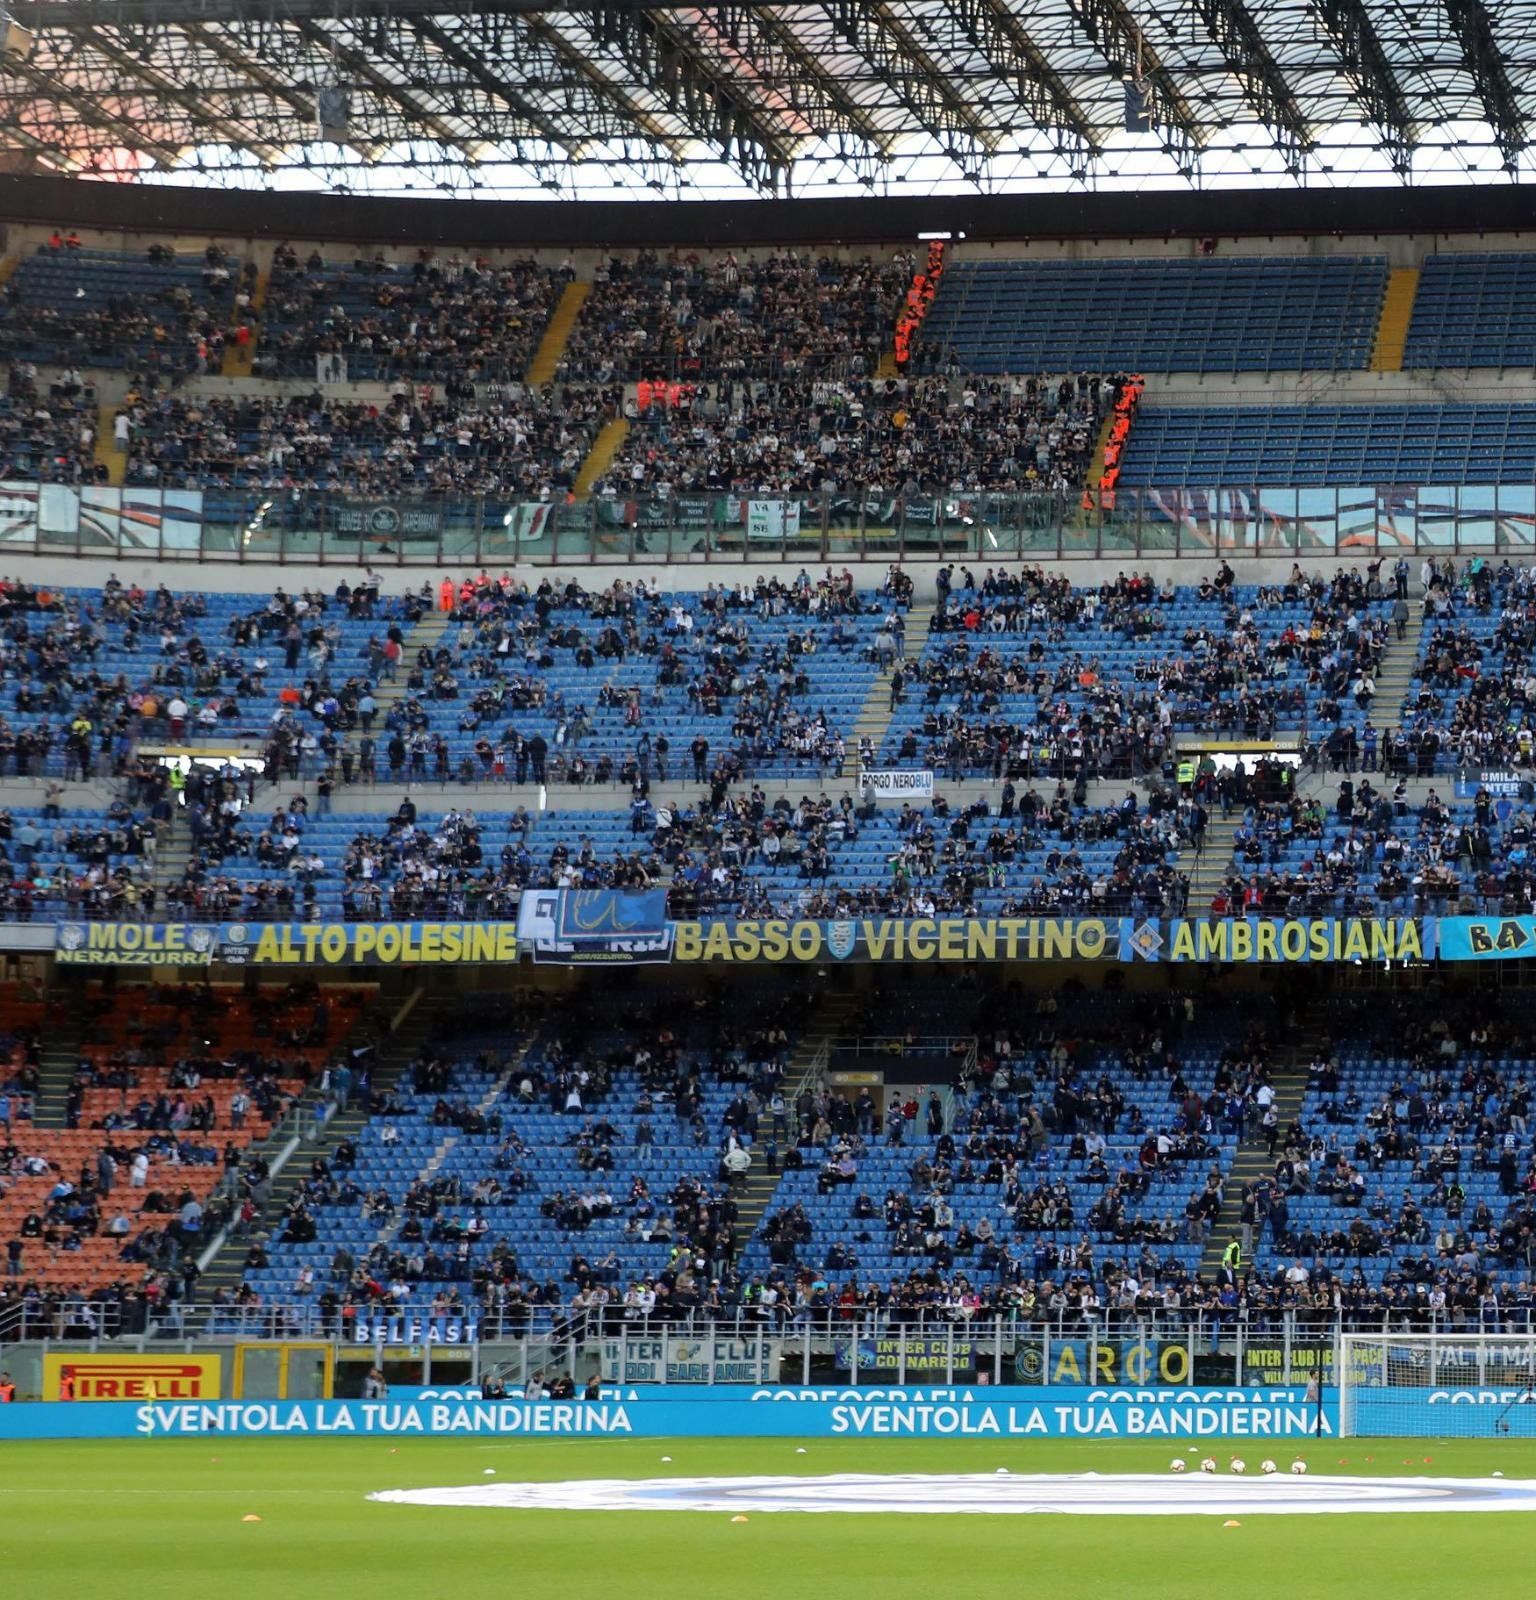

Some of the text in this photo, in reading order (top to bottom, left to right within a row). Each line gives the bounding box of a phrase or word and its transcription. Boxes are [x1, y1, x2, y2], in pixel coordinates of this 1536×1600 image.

[893, 774, 932, 788] NEROBLU
[89, 922, 186, 949] MOLE
[254, 923, 518, 962] ALTO POLESINE
[675, 918, 1107, 961] BASSO VICENTINO
[1171, 920, 1423, 961] AMBROSIANA
[55, 950, 213, 964] NERAZZURRA
[356, 1325, 477, 1342] BELFAST
[715, 1343, 772, 1360] CLUB
[877, 1341, 971, 1354] INTER CLUB
[1248, 1350, 1282, 1367] INTER
[1053, 1345, 1189, 1383] ARCO
[136, 1404, 632, 1433] SVENTOLA LA TUA BANDIERINA
[831, 1405, 1333, 1435] SVENTOLA LA TUA BANDIERINA
